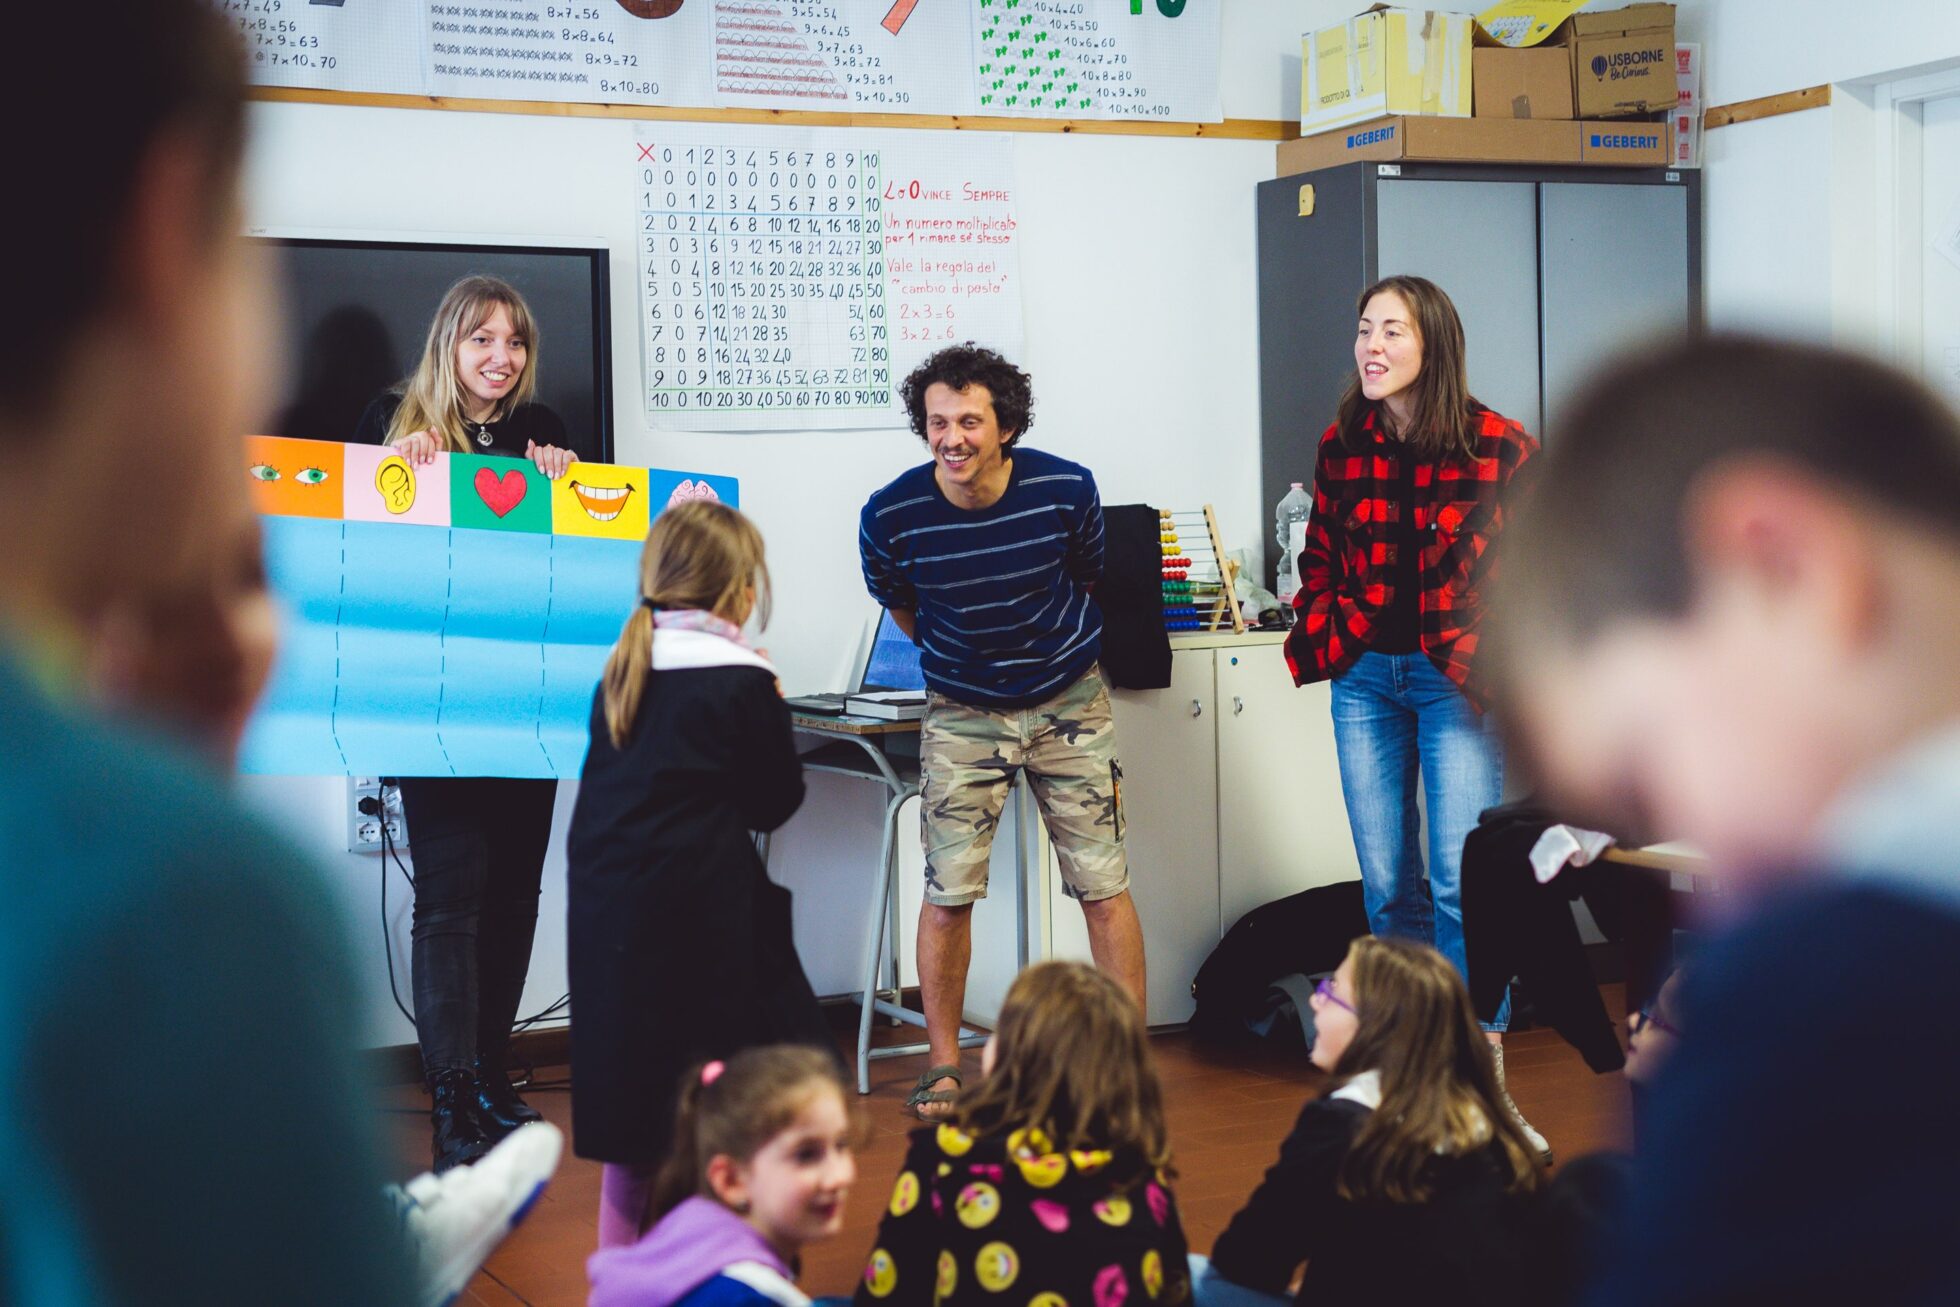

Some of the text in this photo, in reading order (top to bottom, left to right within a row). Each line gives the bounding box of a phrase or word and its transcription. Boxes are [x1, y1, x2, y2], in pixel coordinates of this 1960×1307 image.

[1608, 49, 1664, 67] USBORNE
[1610, 67, 1622, 81] Be
[1355, 126, 1396, 147] GEBERIT
[1603, 135, 1659, 149] GEBERIT
[664, 148, 671, 163] 0
[686, 149, 693, 164] 1
[704, 149, 713, 164] 2
[726, 150, 735, 165] 3
[747, 151, 755, 168] 4
[770, 151, 778, 165] 5
[788, 152, 796, 166] 6
[806, 153, 813, 166] 7
[826, 153, 835, 168] 8
[846, 153, 854, 167] 9
[864, 154, 877, 168] 10
[922, 189, 951, 201] VINCE
[645, 215, 880, 235] 2 2 4 6 8 10 12 14 16 18 20
[884, 213, 1017, 232] Un numero moltiplicato
[647, 238, 881, 256] 3 3 6 9 12 15 18 21 24 27 30
[885, 235, 904, 249] per
[908, 232, 914, 246] 1
[919, 234, 956, 243] rimane
[977, 233, 1010, 245] stesso
[648, 260, 881, 279] 4 4 8 12 16 20 24 28 32 36 40
[886, 257, 996, 277] Vale la regola del
[648, 282, 882, 300] 5 5 10 15 20 25 30 35 40 45 50
[952, 280, 963, 294] di
[652, 304, 883, 322] 6 6 12 18 24 30 54 60
[653, 326, 886, 344] 7 7 14 21 28 35 63 70
[656, 347, 887, 365] 8 8 16 24 32 40 72 80
[654, 368, 887, 387] 9 9 18 27 36 45 54 63 72 81 90
[652, 391, 888, 408] 10 0 10 20 30 40 50 60 70 80 90 100
